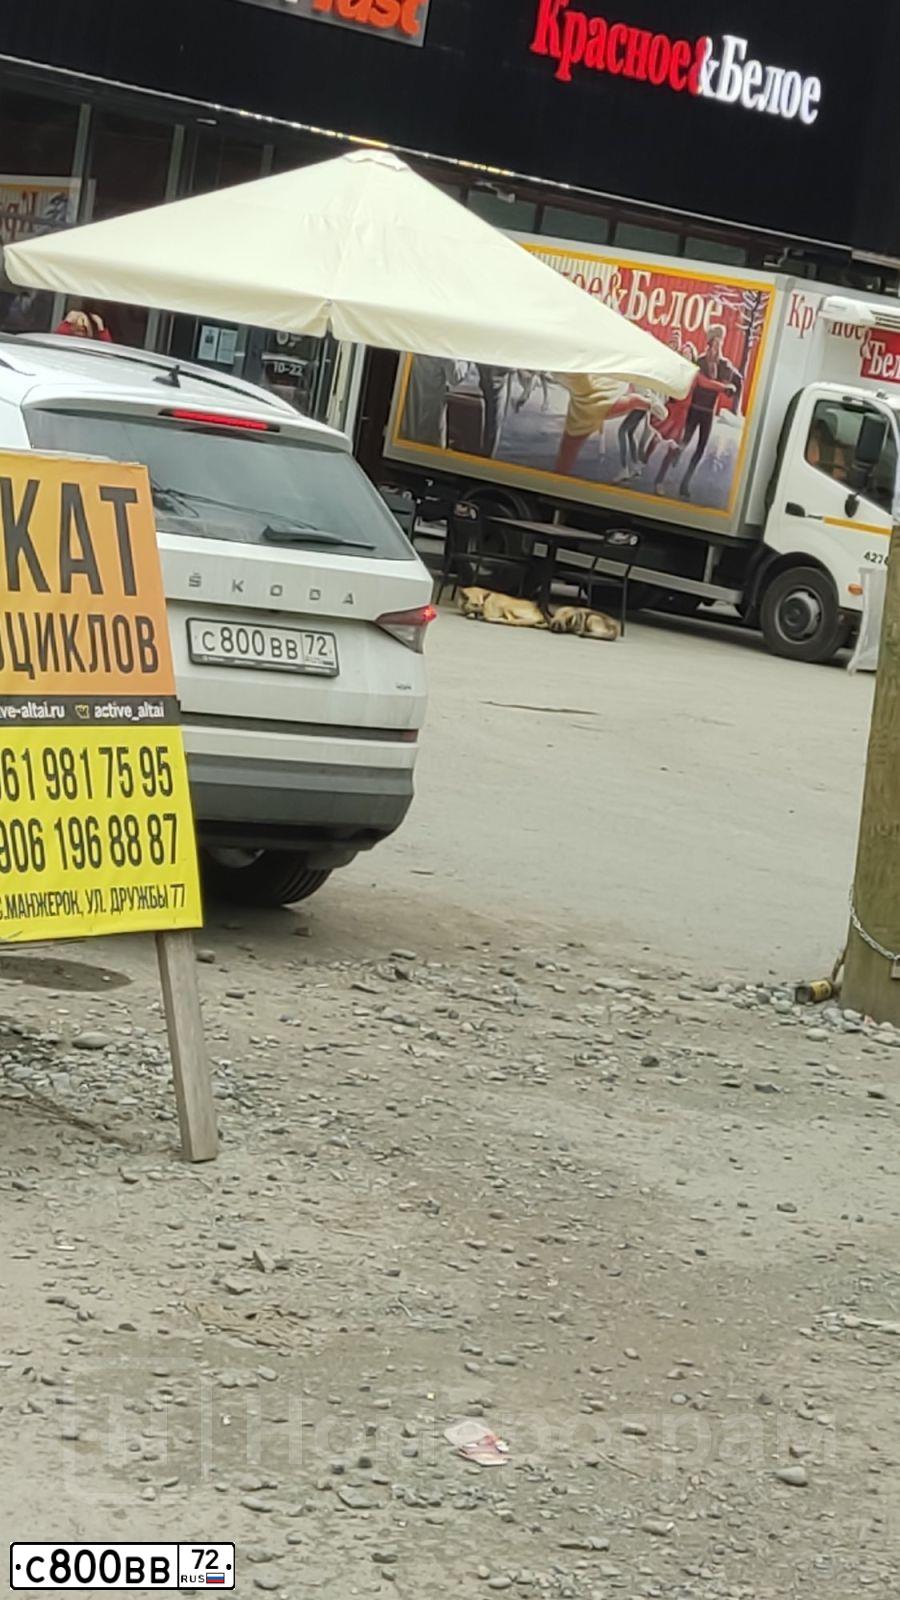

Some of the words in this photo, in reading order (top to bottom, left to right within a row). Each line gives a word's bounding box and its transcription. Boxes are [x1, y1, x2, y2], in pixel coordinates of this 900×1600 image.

[530, 0, 822, 125] Красное&Белое
[562, 269, 724, 334] ое&Белое
[0, 476, 138, 597] КАТ
[189, 573, 355, 605] ŠKODA
[304, 634, 328, 656] 72
[94, 701, 165, 721] active_altai
[0, 747, 35, 802] 61
[42, 747, 93, 800] 981
[98, 746, 134, 799] 75
[139, 746, 174, 798] 95
[0, 818, 46, 874] 906
[54, 816, 101, 871] 196
[108, 814, 142, 868] 88
[147, 813, 177, 866] 87
[85, 889, 107, 915] УЛ.
[110, 884, 168, 915] ДРУЖБЫ
[170, 883, 186, 909] 77
